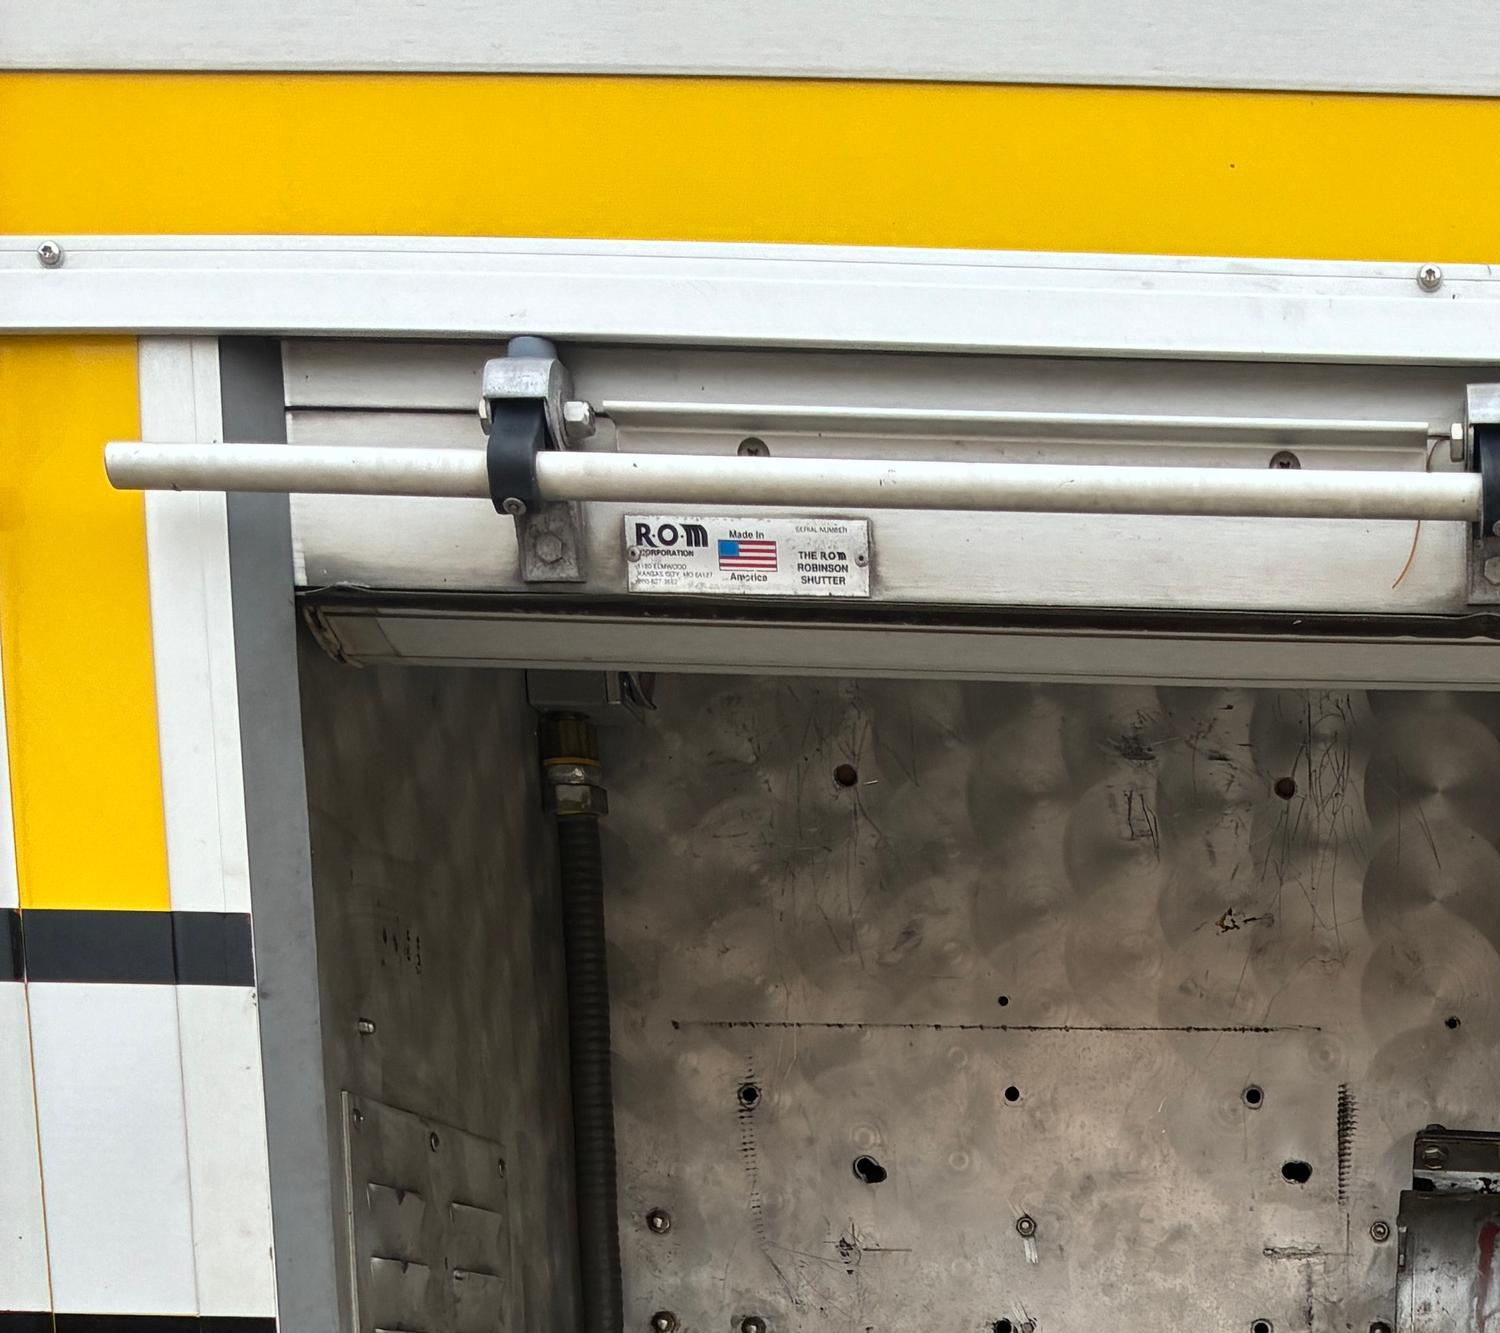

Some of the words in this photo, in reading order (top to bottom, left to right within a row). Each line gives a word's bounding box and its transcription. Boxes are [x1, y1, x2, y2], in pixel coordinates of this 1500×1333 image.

[729, 530, 753, 539] Made
[756, 531, 764, 539] In
[798, 551, 818, 560] THE
[797, 563, 849, 573] ROBINSON
[730, 572, 768, 581] America
[801, 575, 846, 585] SHUTTER
